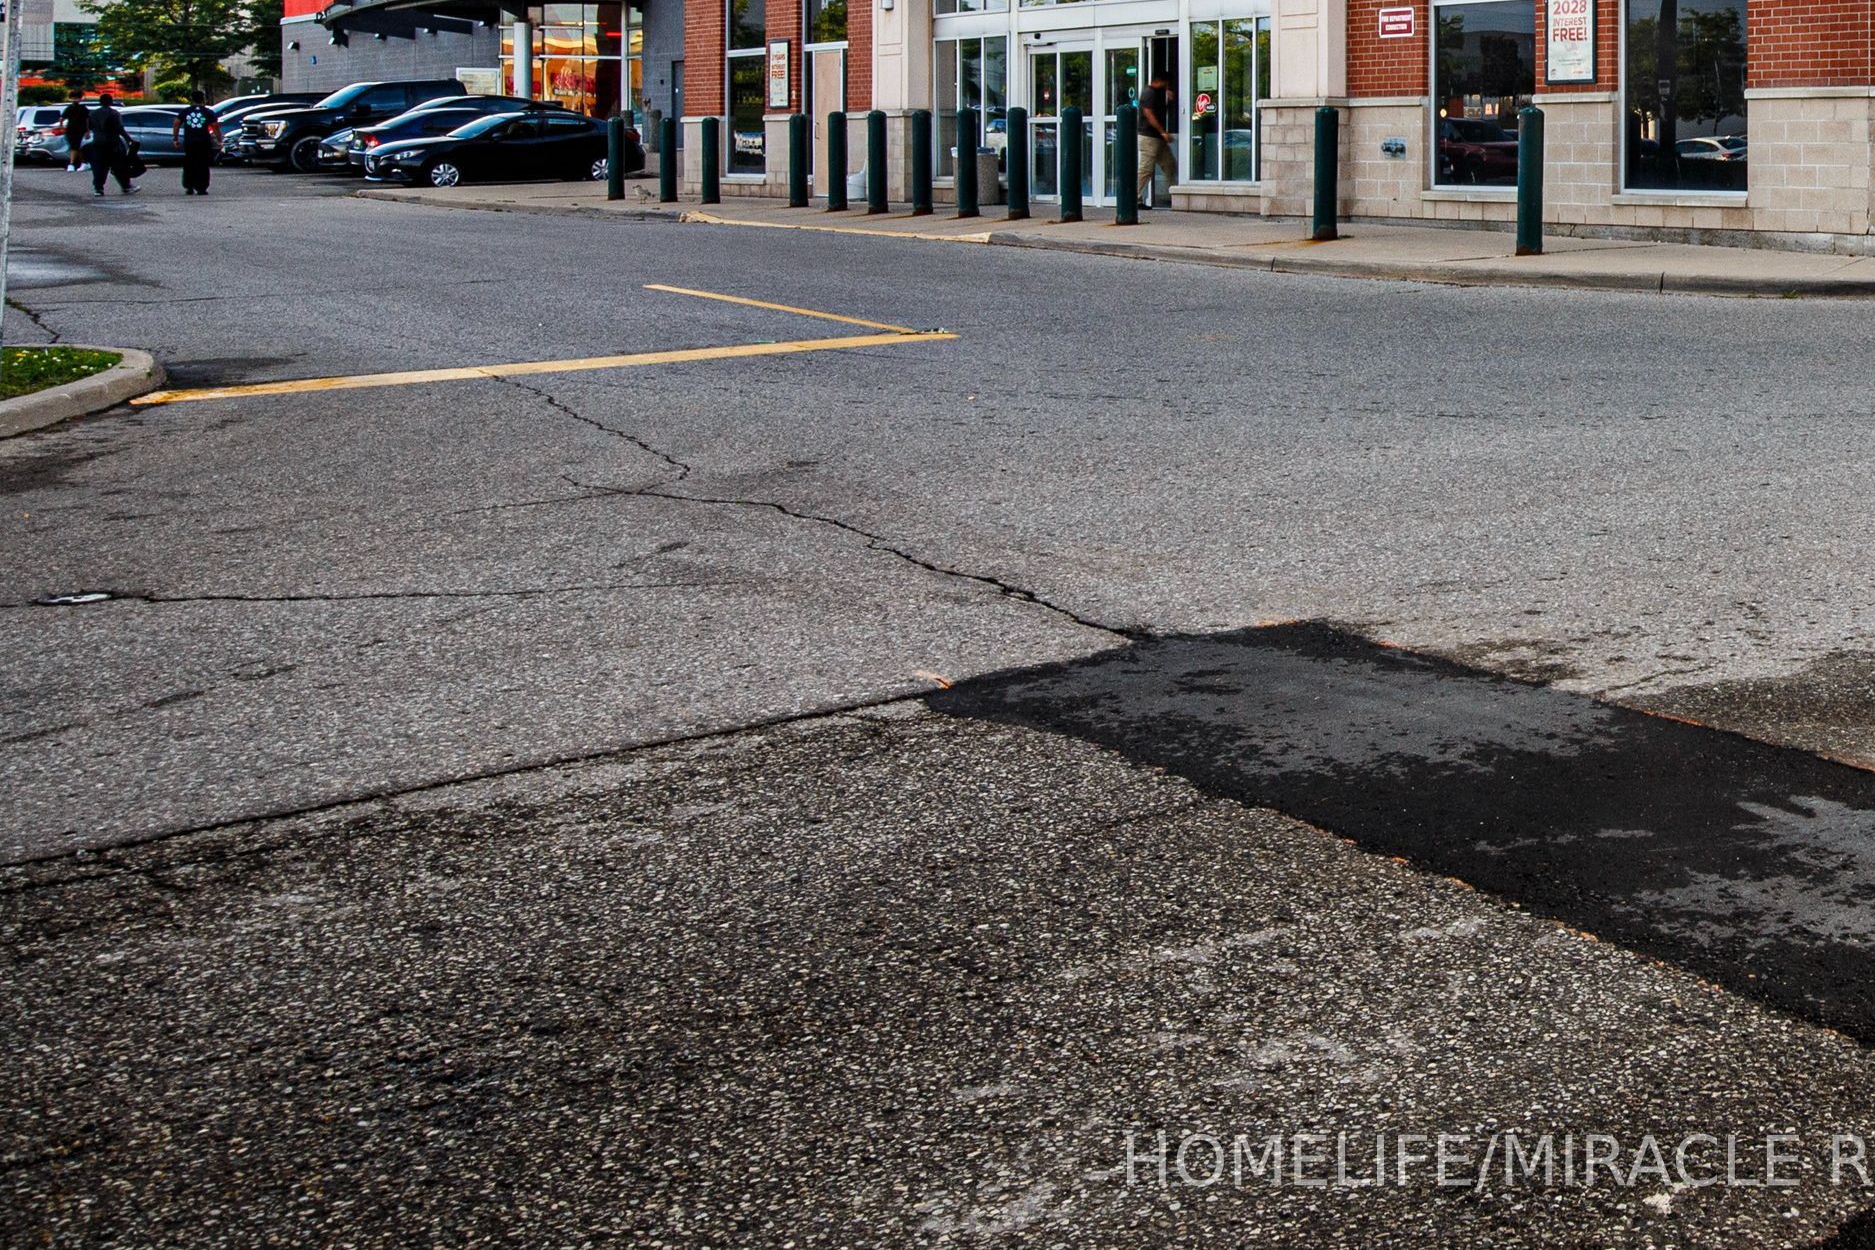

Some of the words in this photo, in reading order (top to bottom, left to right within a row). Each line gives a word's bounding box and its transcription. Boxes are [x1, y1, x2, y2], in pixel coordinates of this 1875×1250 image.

[1553, 0, 1587, 15] 2028
[1553, 17, 1587, 27] INTEREST
[1553, 27, 1587, 42] FREE!
